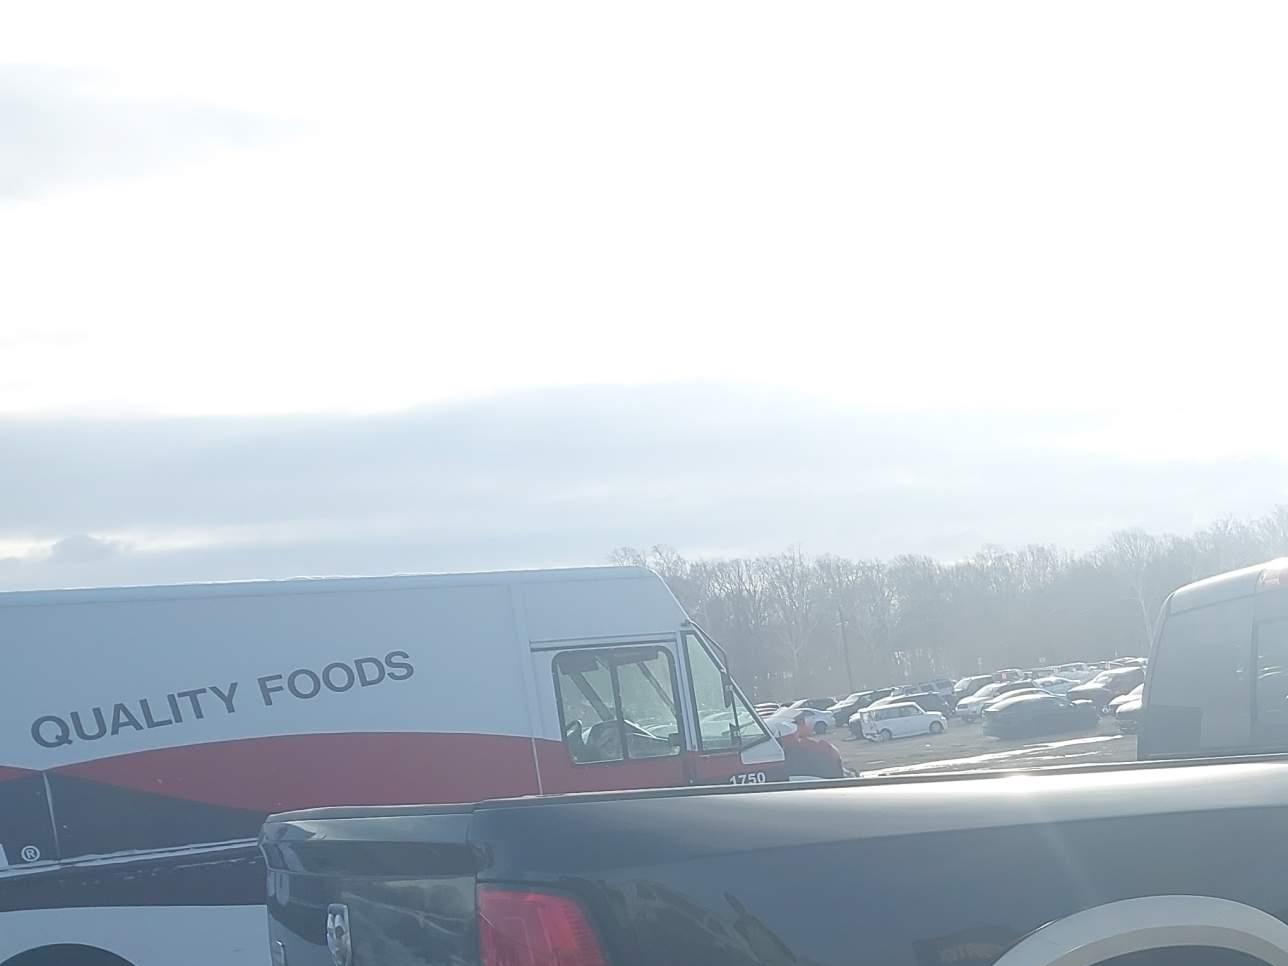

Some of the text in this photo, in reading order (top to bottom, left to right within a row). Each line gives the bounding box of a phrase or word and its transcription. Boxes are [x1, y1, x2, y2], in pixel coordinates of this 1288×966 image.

[30, 649, 414, 748] QUALITY FOODS
[729, 771, 766, 786] 1750
